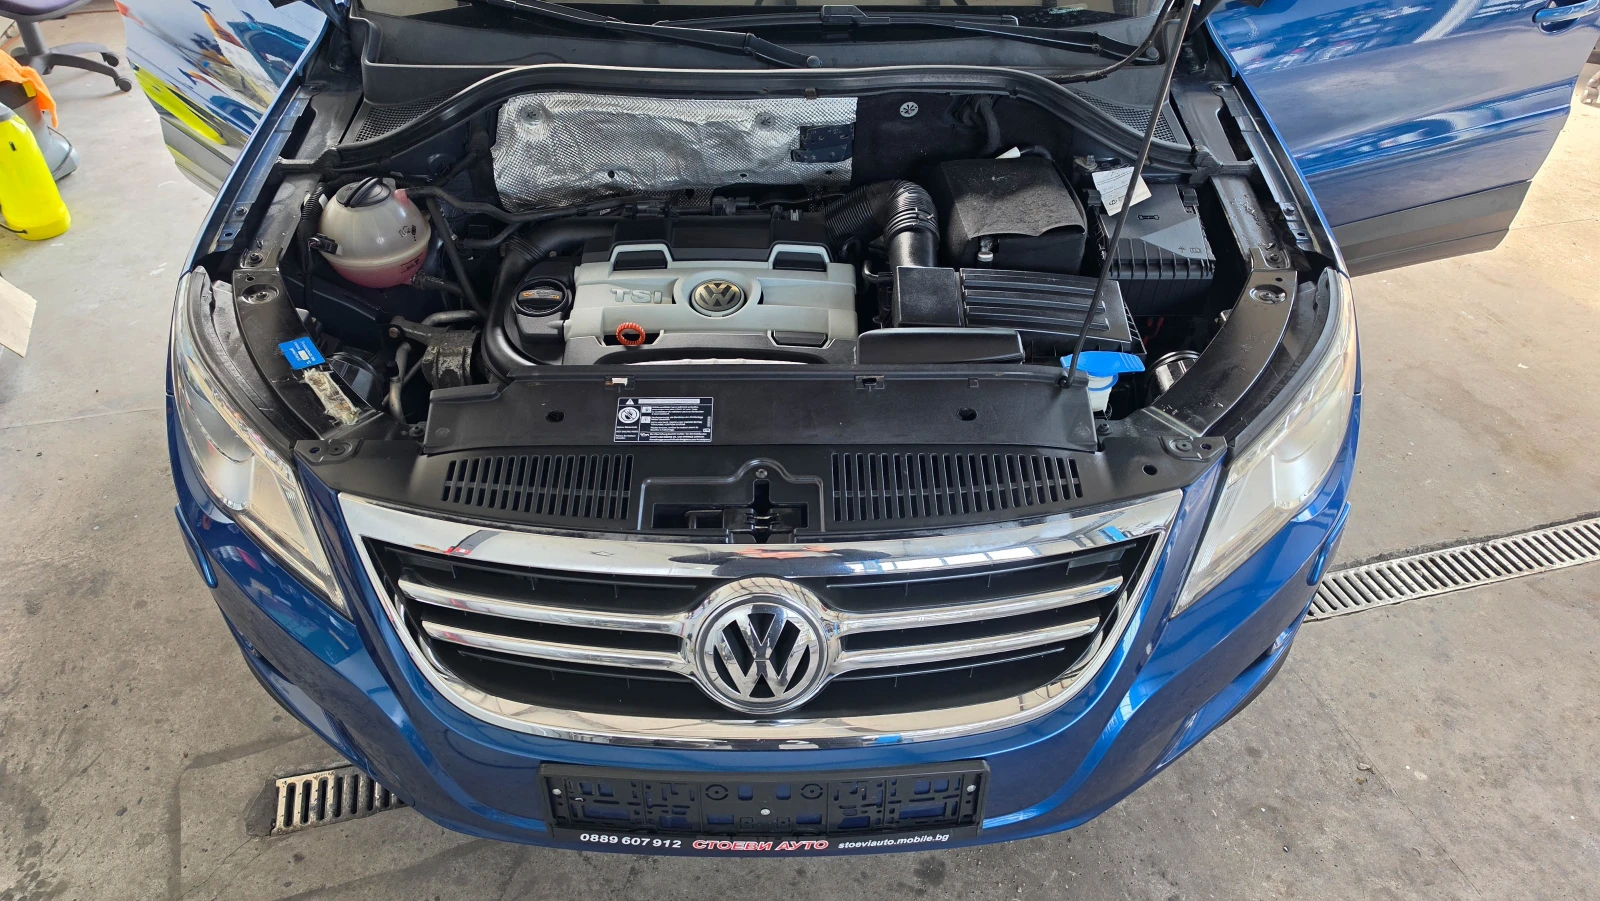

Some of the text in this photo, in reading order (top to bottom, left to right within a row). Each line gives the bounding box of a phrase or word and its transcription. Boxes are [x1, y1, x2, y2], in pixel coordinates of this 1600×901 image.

[610, 288, 662, 304] TSI
[712, 602, 811, 699] VW
[580, 833, 682, 848] 0889 607 912
[692, 839, 829, 851] СТОЕВИ АУТО
[838, 833, 949, 849] stoeviauto.mobile.bg
